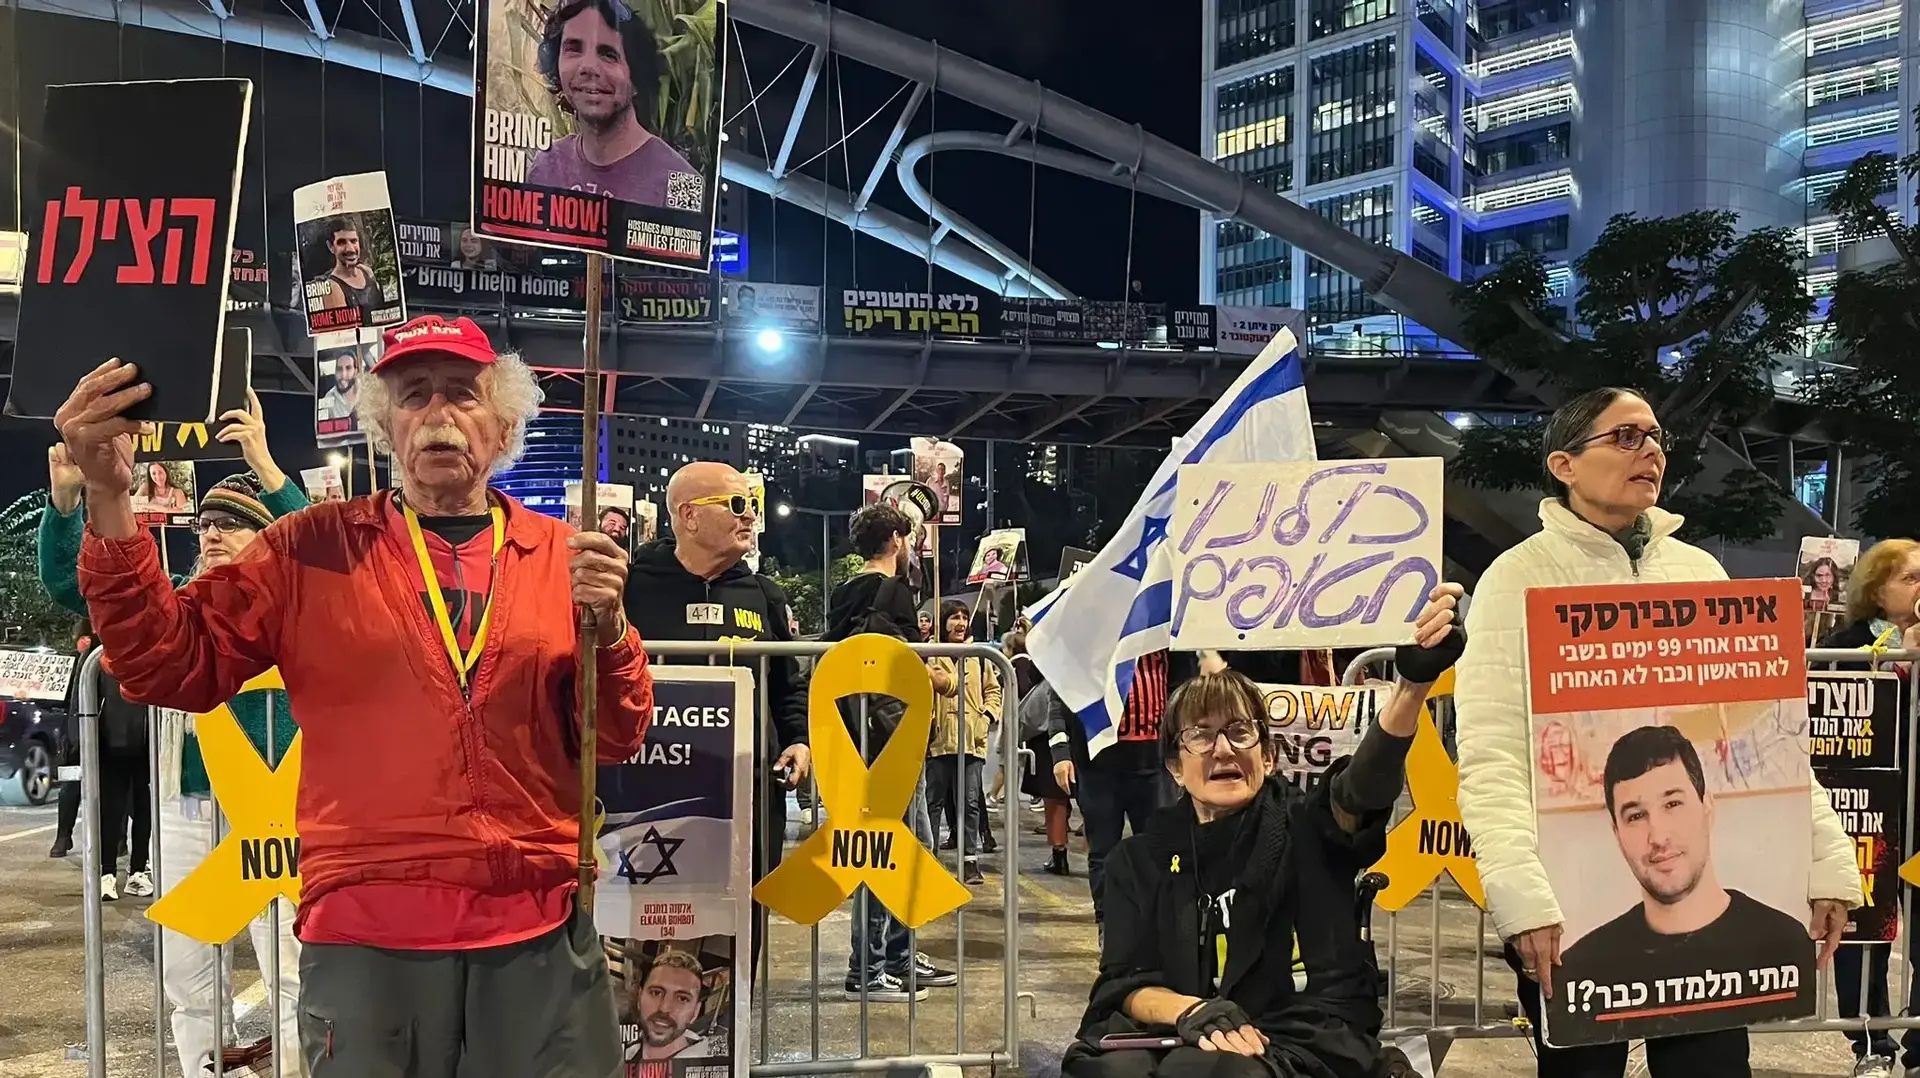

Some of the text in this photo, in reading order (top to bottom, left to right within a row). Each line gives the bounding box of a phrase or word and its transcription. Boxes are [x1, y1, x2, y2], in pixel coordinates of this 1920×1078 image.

[485, 108, 552, 151] BRING
[484, 144, 525, 183] HIM
[483, 185, 544, 225] HOME
[550, 194, 608, 236] NOW!
[37, 186, 216, 284] הצילו
[399, 224, 440, 242] מחזירים
[627, 219, 702, 240] HOSTAGES AND MISSING
[400, 240, 440, 258] את ענבר
[627, 230, 701, 256] FAMILIES FORUM
[305, 280, 332, 298] BRING
[418, 267, 464, 293] Bring
[470, 269, 517, 294] Them
[521, 274, 569, 297] Home
[642, 296, 711, 320] לעסקה
[843, 289, 979, 311] ללא החטופים
[310, 310, 334, 328] HOME
[335, 307, 362, 324] NOW!
[844, 306, 902, 332] ריק!
[908, 310, 979, 333] הבית
[1174, 310, 1209, 326] מחזירים
[1175, 325, 1209, 339] את ענבר
[1178, 462, 1430, 555] כולנו
[1170, 551, 1439, 639] חטופים
[692, 606, 719, 620] 417
[734, 607, 764, 633] NOW.
[1555, 595, 1778, 638] איתי סבירסקי
[1559, 635, 1778, 662] נרצח אחרי 99 ימים בשבי
[1550, 656, 1789, 694] לא הראשון וכבר לא האחרון
[1808, 682, 1874, 717] עוצרי
[1811, 717, 1863, 737] את המד
[1848, 738, 1872, 759] סוף
[1861, 812, 1883, 833] את
[832, 829, 896, 870] NOW.
[1419, 819, 1476, 859] NOW.
[640, 914, 695, 925] ELKANA BOHBOT
[660, 926, 675, 938] (34)
[1566, 964, 1799, 1014] מתי תלמדו כבר?!
